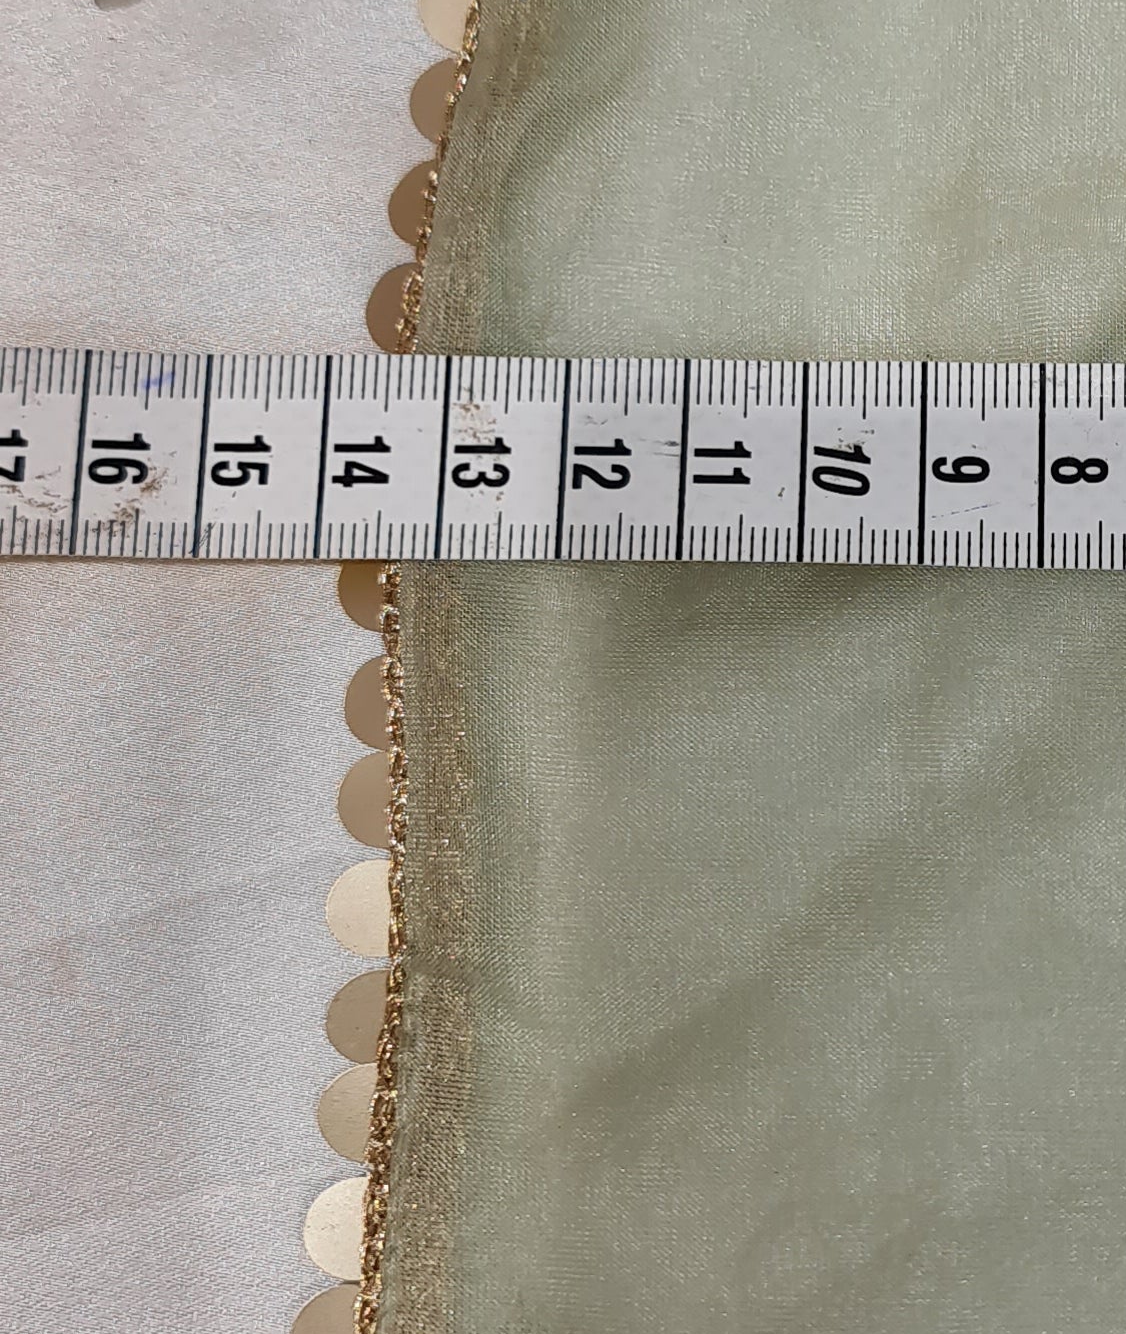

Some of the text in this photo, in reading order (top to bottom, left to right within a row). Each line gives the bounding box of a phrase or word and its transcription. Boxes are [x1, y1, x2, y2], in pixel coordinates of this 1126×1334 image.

[88, 432, 151, 485] 16
[210, 435, 271, 487] 15
[331, 435, 391, 488] 14
[451, 437, 512, 489] 13
[571, 438, 632, 490] 12
[692, 440, 752, 485] 11
[811, 443, 872, 497] 10
[931, 456, 991, 484] 9
[1050, 456, 1109, 485] 8
